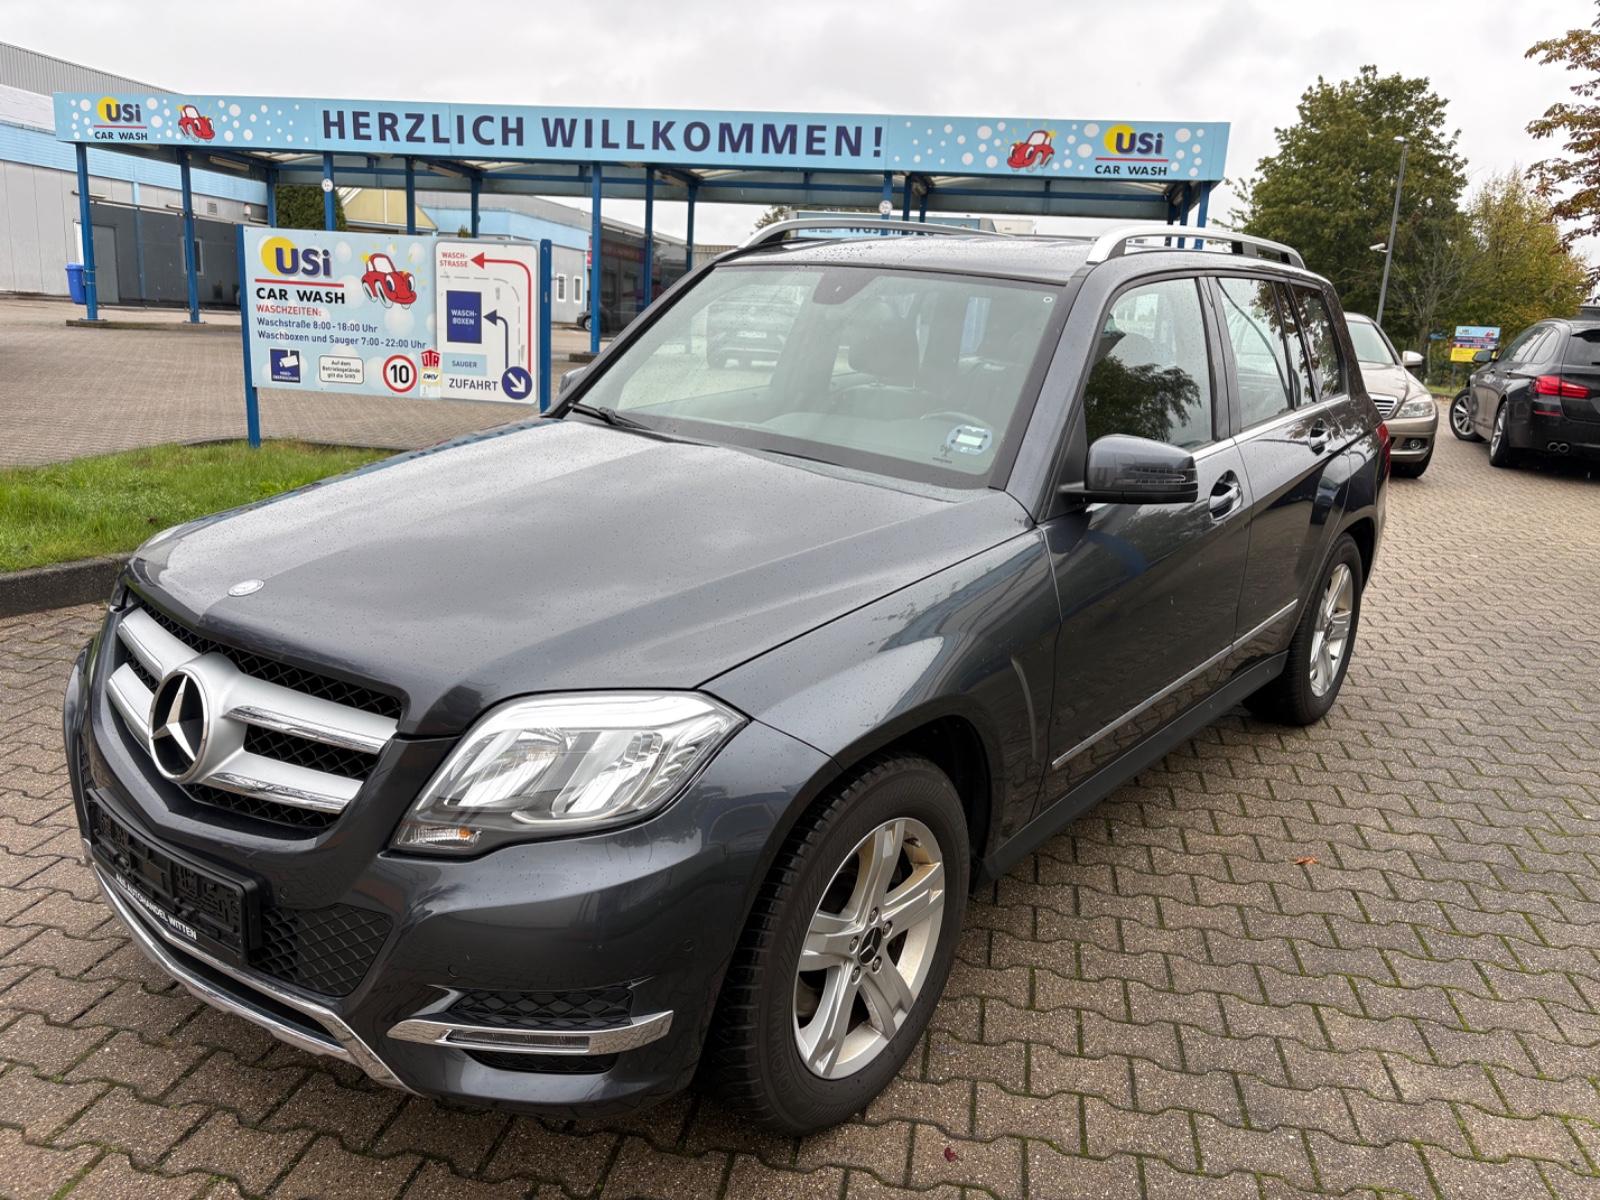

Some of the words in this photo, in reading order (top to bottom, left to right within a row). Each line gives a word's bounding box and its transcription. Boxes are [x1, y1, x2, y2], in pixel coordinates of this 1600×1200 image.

[94, 131, 115, 140] CAR
[119, 131, 148, 141] WASH
[322, 110, 524, 147] HERZLICH
[541, 117, 883, 158] WILLKOMMEN!
[1095, 164, 1121, 175] CAR
[1128, 165, 1168, 176] WASH
[439, 260, 468, 268] STRASSE
[256, 287, 289, 301] CAR
[296, 289, 345, 304] WASH
[256, 303, 322, 317] WASCHZEITEN:
[451, 309, 478, 317] WASCH-
[256, 317, 311, 330] Waschstraße
[313, 320, 332, 331] 8:00
[338, 321, 361, 332] 18:00
[362, 323, 379, 333] Uhr
[452, 317, 475, 326] BOXEN
[257, 330, 310, 343] Waschboxen
[311, 334, 327, 344] und
[329, 336, 359, 347] Sauger
[362, 337, 380, 347] 7:00
[385, 338, 409, 348] 22:00
[410, 339, 427, 349] Uhr
[421, 350, 440, 368] UTA
[452, 360, 478, 368] SAUGER
[390, 364, 410, 384] 10
[449, 378, 499, 391] ZUFAHRT
[168, 915, 197, 940] WITTEN
